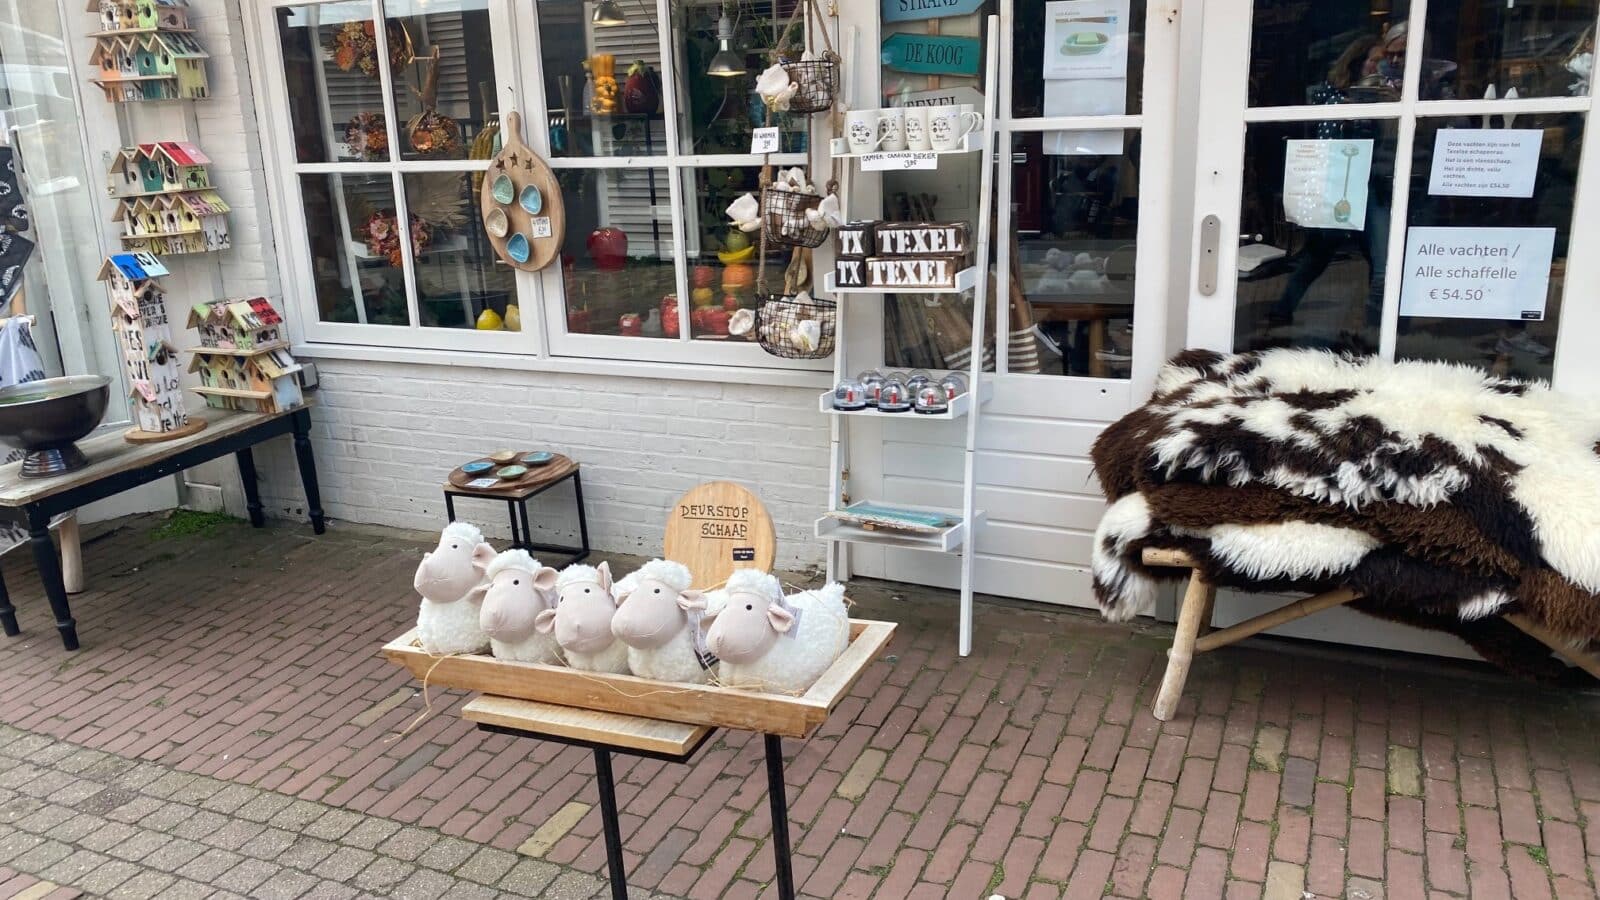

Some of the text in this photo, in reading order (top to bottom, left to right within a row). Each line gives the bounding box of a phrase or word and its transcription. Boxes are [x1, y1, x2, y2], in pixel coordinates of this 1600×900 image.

[905, 43, 963, 65] DE KOOG
[839, 230, 863, 254] TX
[878, 229, 962, 253] TEXEL
[1417, 243, 1521, 259] Alle vachten /
[837, 260, 861, 284] TX
[868, 260, 951, 285] TEXEL
[1415, 266, 1518, 279] Alle schaffelle
[1442, 288, 1483, 301] 54.50
[680, 505, 749, 518] DEURSTOP
[701, 522, 748, 537] SCHAAP
